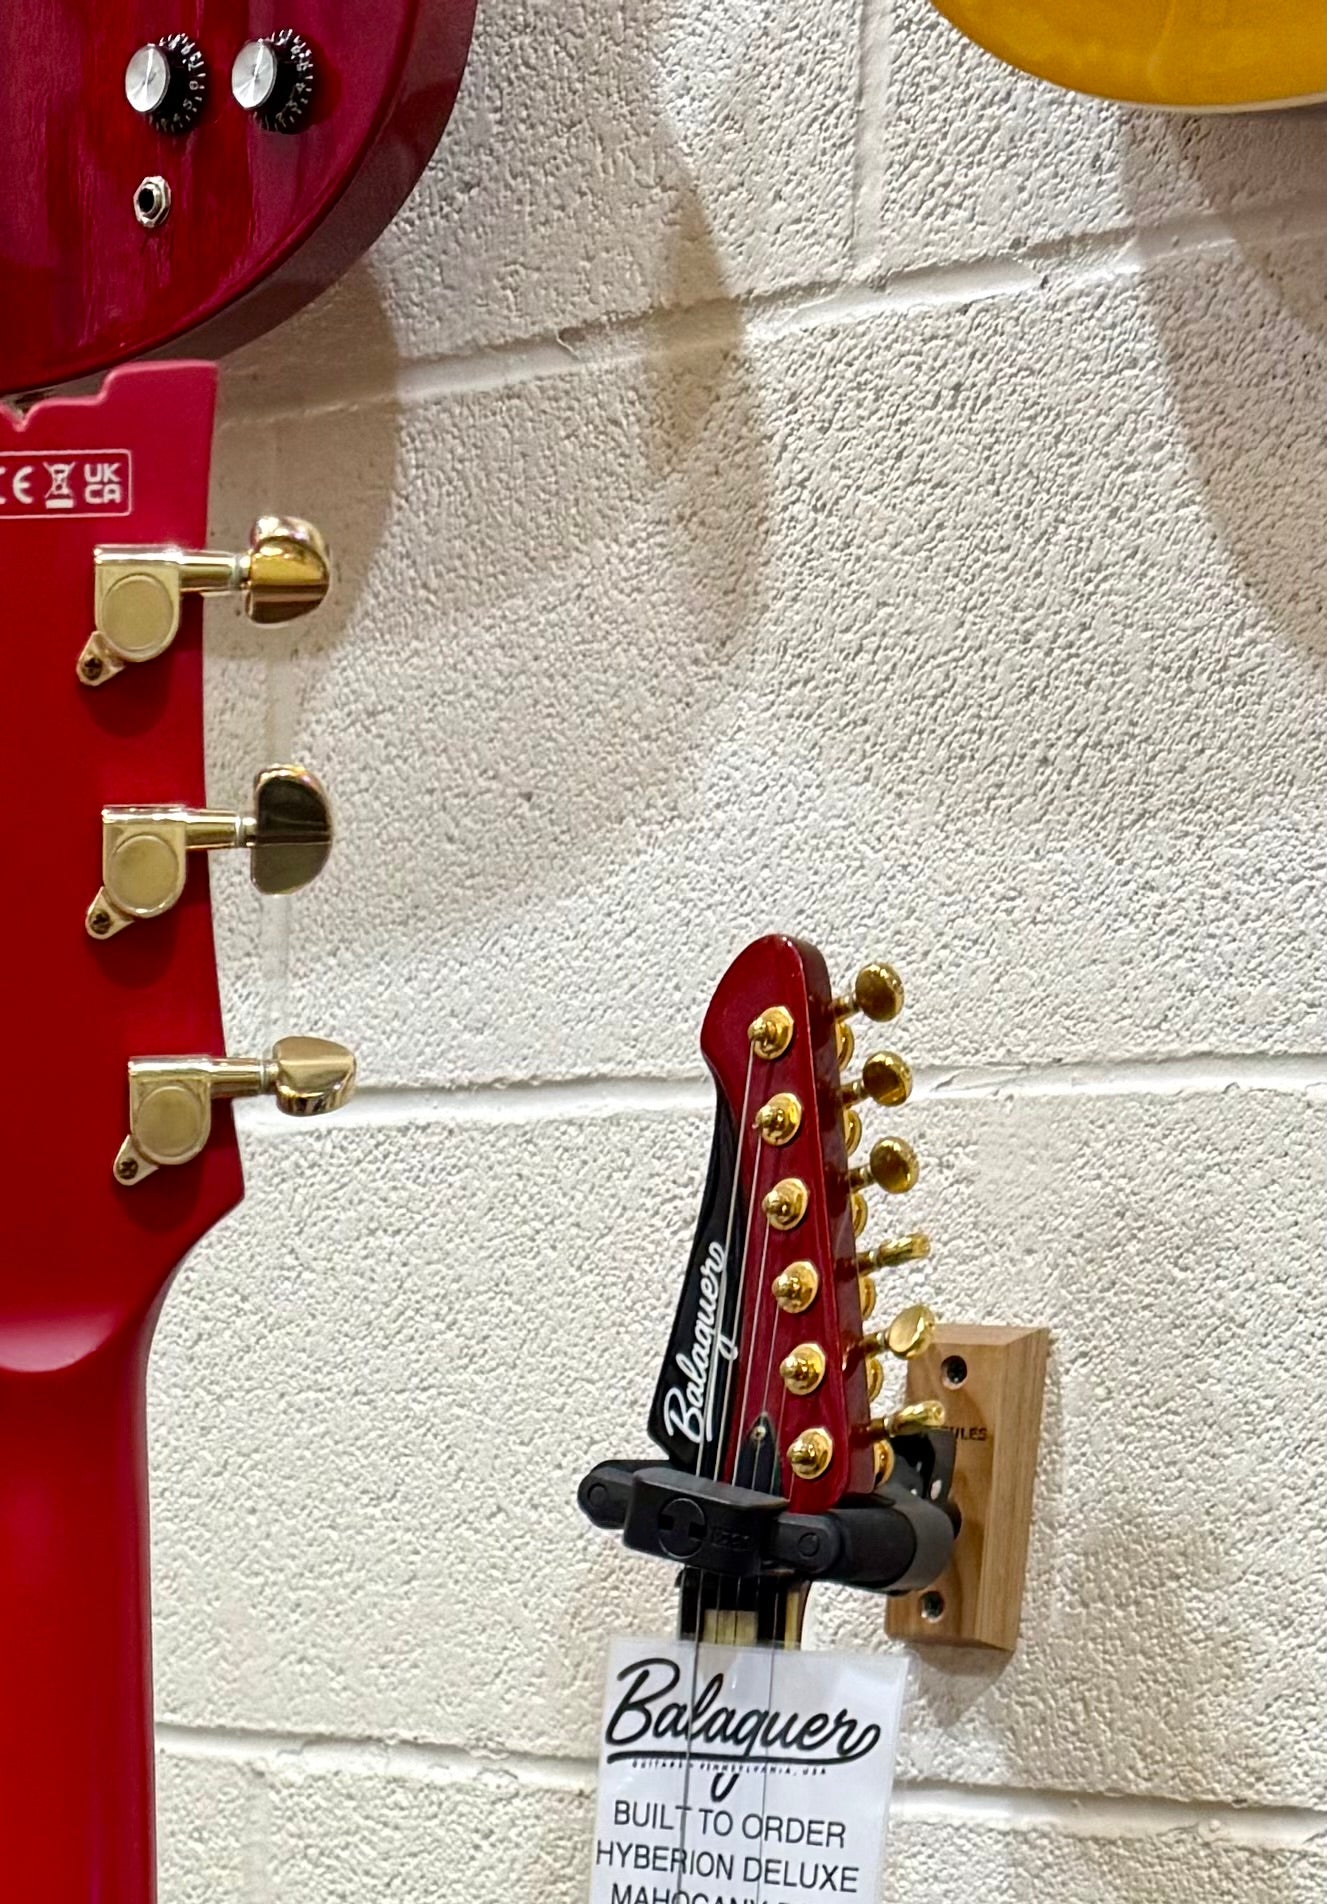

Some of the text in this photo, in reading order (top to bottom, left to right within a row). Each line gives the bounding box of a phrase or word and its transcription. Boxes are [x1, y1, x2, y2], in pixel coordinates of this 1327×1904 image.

[83, 463, 121, 483] UK
[84, 484, 121, 504] CA
[663, 1241, 738, 1443] Balaguer
[605, 1657, 880, 1800] Balaguer
[614, 1800, 846, 1848] BUILT TO ORDER
[596, 1841, 860, 1893] HYBERION DELUXE
